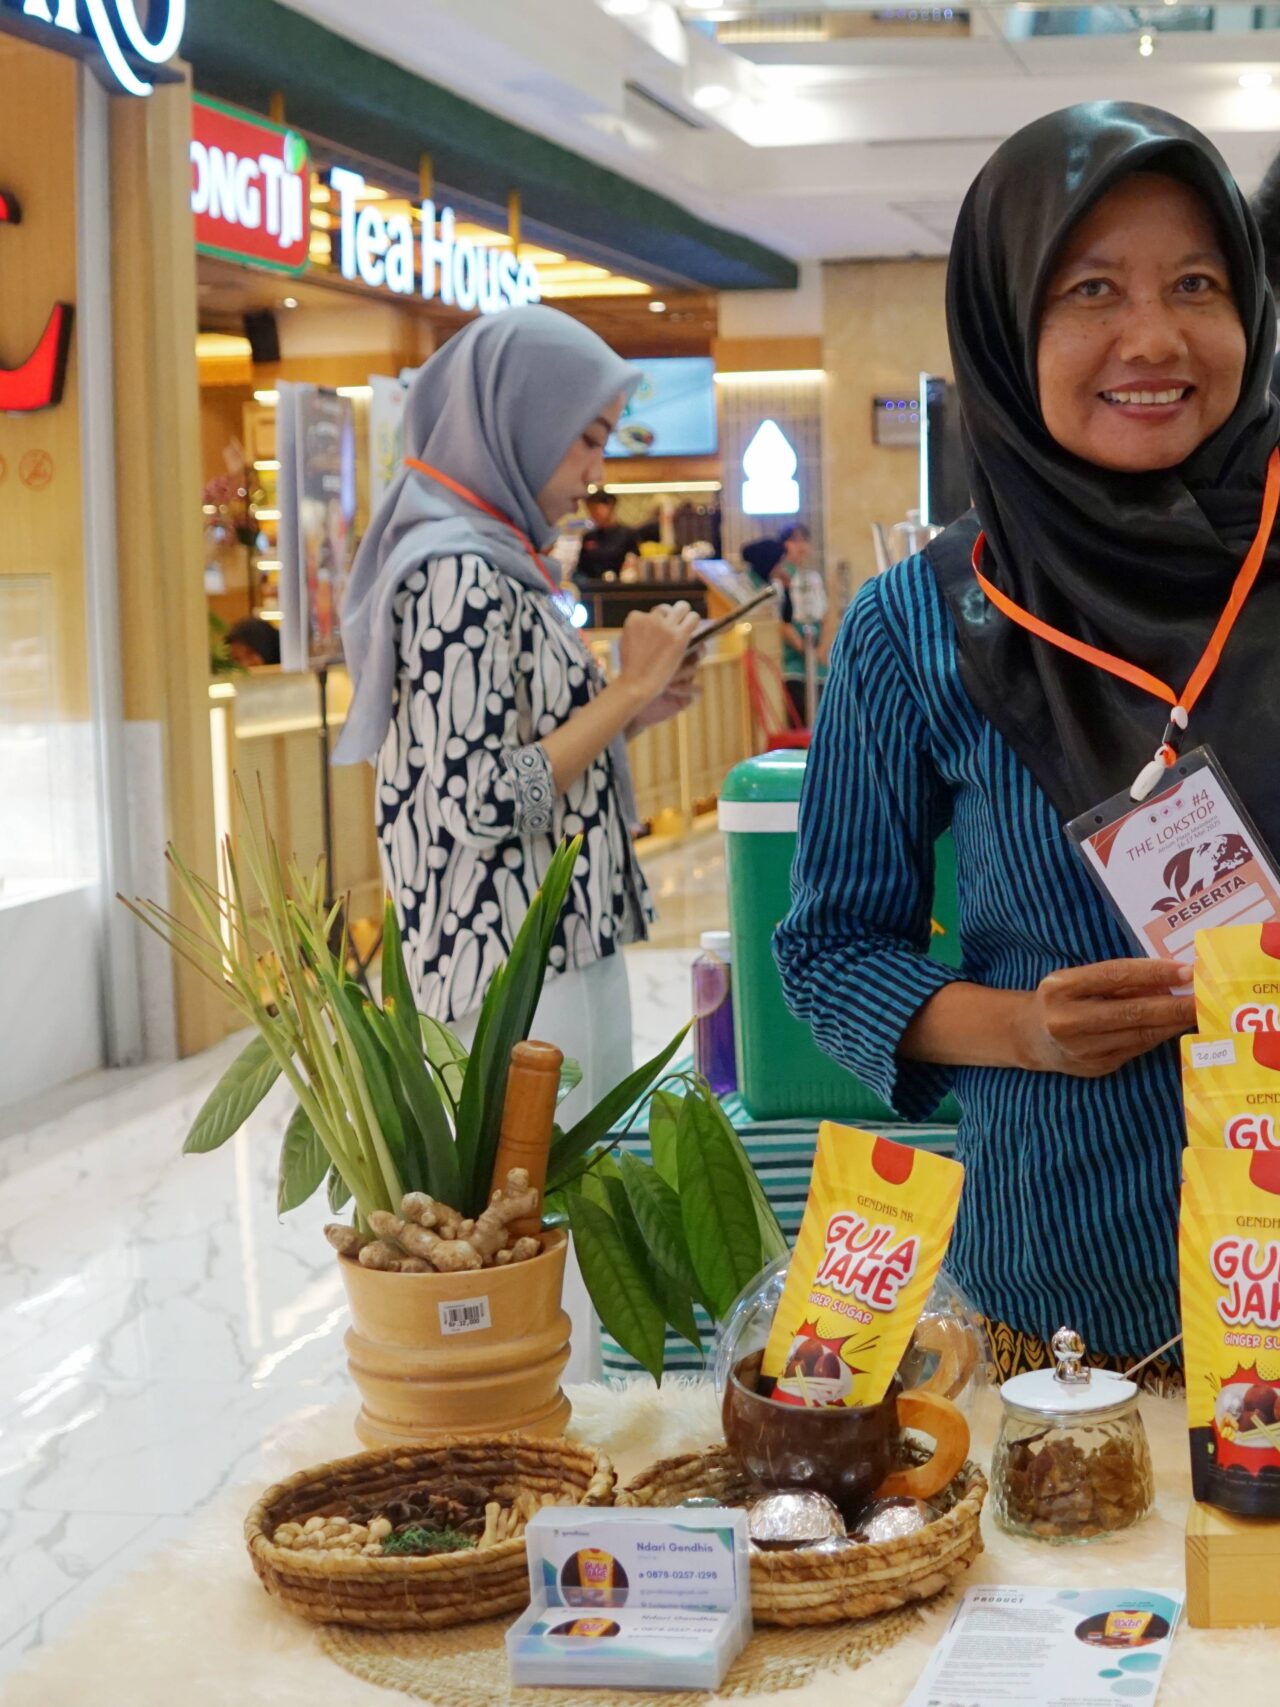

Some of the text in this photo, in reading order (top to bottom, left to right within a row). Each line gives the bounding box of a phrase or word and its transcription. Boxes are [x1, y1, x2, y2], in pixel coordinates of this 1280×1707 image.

[330, 166, 542, 315] Tea House
[1192, 788, 1208, 807] #4
[1126, 800, 1216, 861] THE LOKSTOP
[1166, 875, 1247, 929] PESERTA
[857, 1195, 914, 1222] GENDHIS NR
[825, 1215, 917, 1274] GULA
[816, 1247, 905, 1305] JAHE
[832, 1299, 874, 1326] SUGAR
[1224, 1333, 1261, 1348] GINGER
[637, 1542, 714, 1553] Ndari Gendhis
[973, 1596, 1025, 1604] PRODUCT
